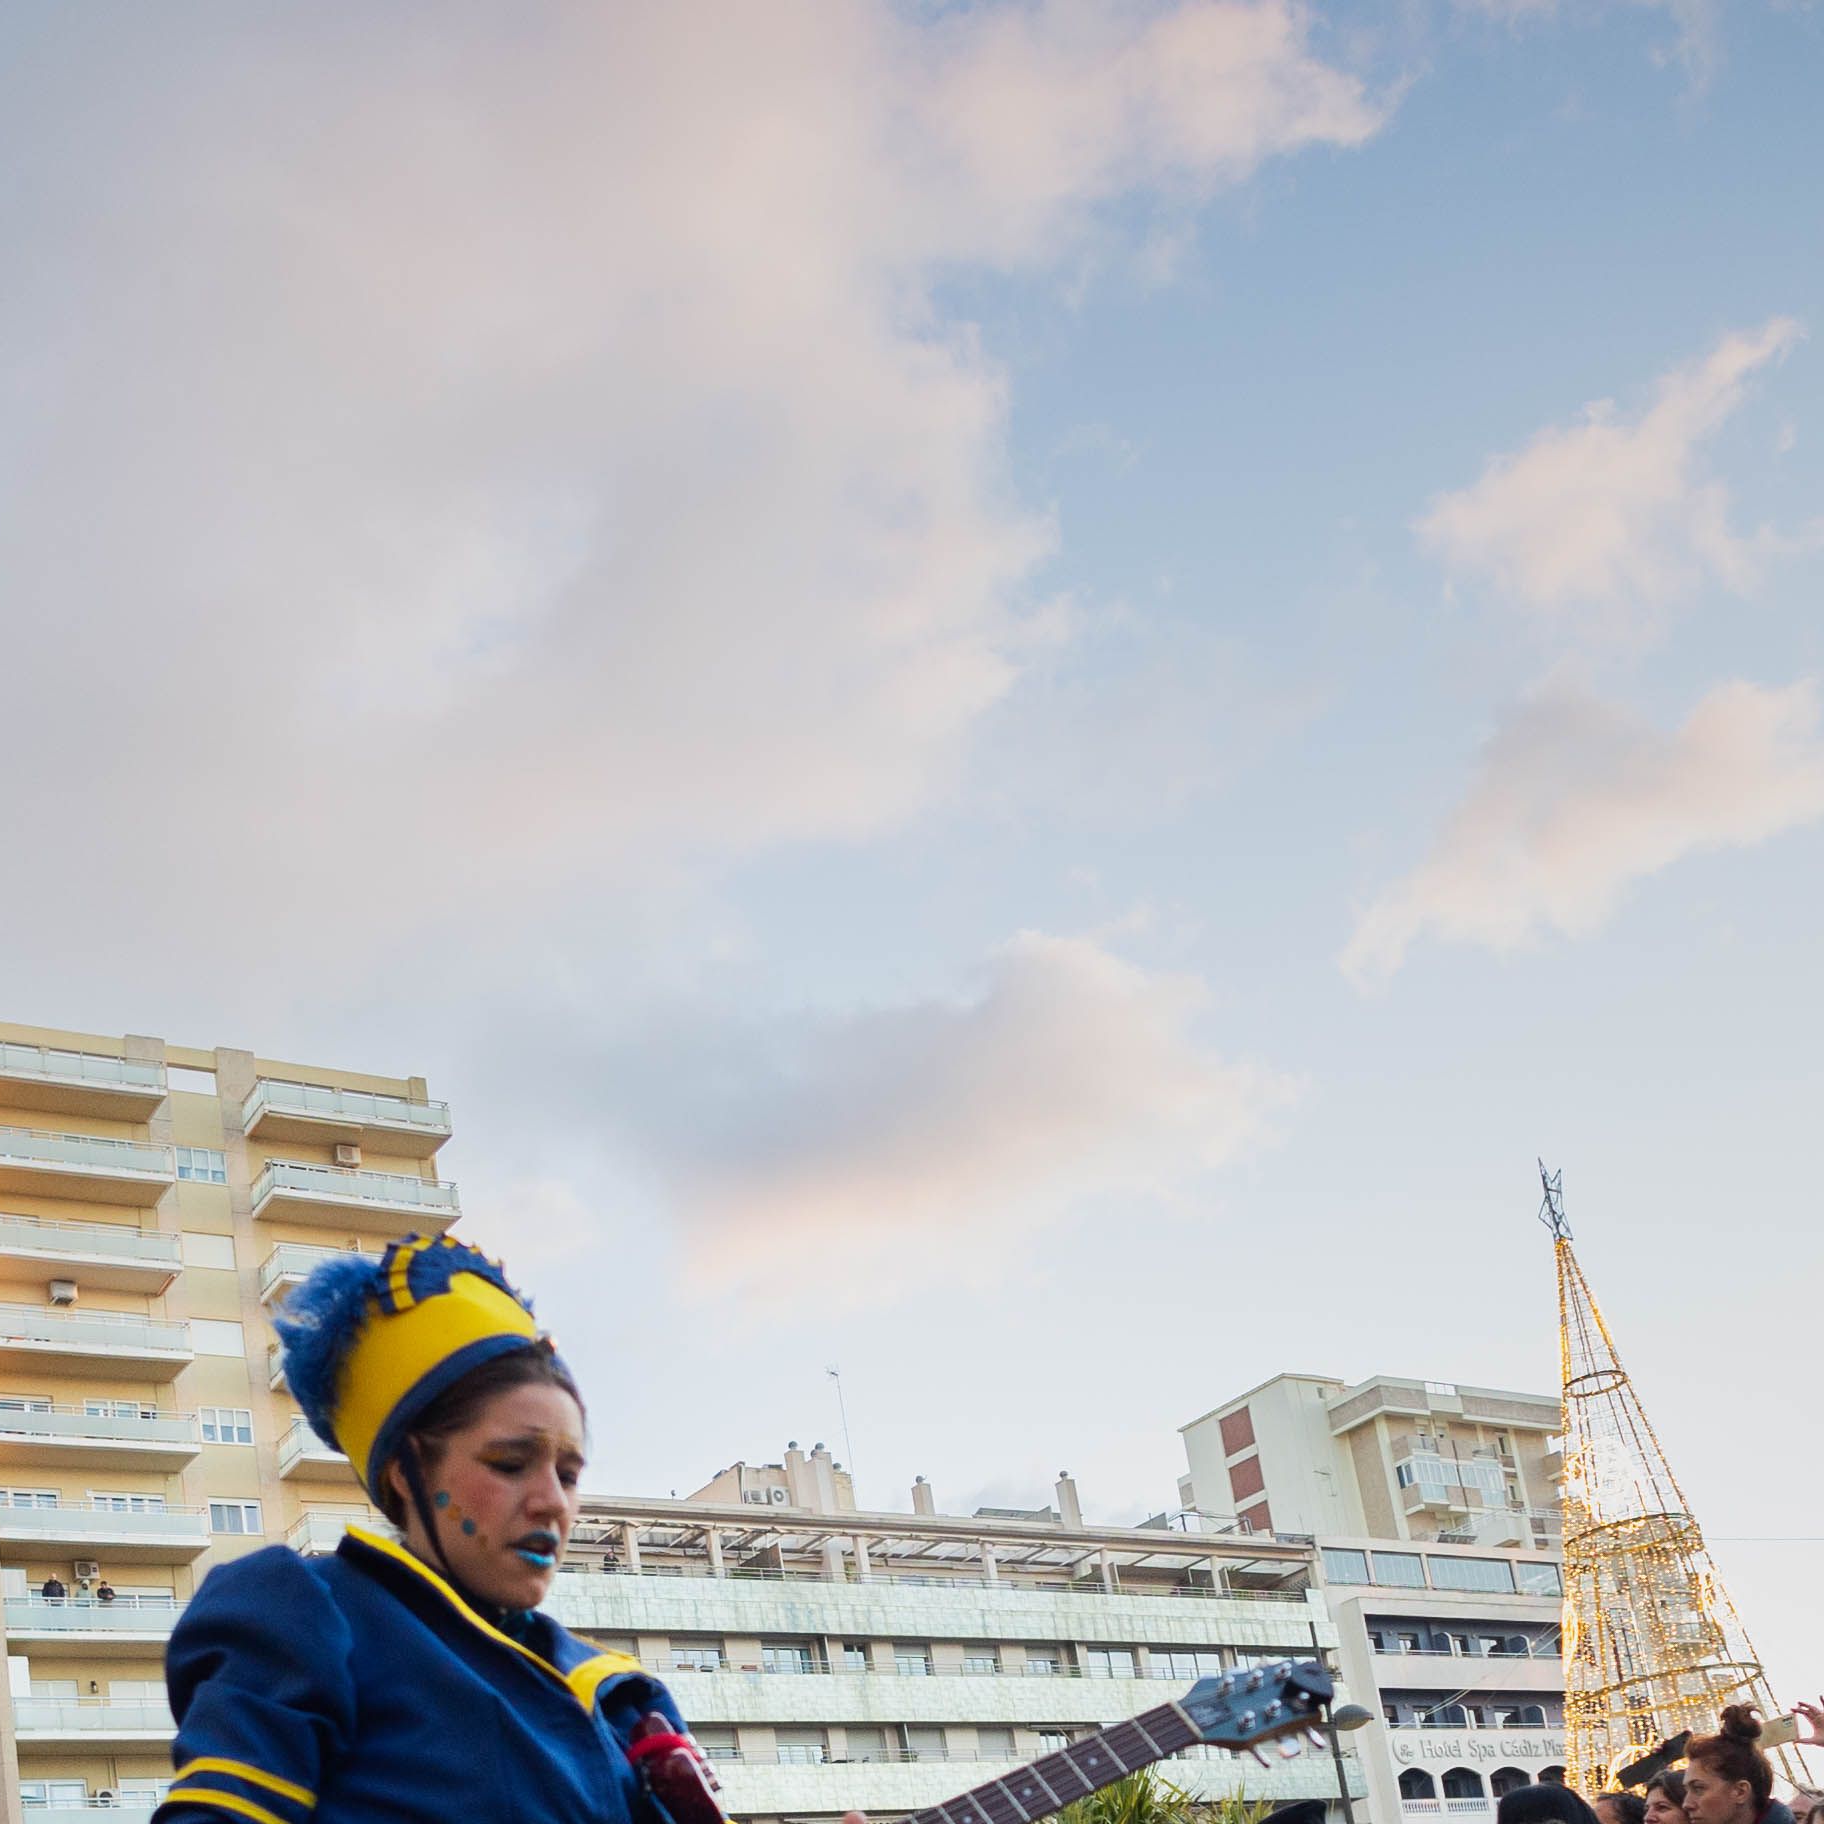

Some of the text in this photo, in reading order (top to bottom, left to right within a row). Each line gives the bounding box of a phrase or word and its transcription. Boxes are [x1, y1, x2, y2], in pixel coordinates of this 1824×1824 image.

[1419, 1739, 1462, 1758] Hotel
[1467, 1739, 1496, 1762] Spa
[1542, 1738, 1568, 1757] Pla
